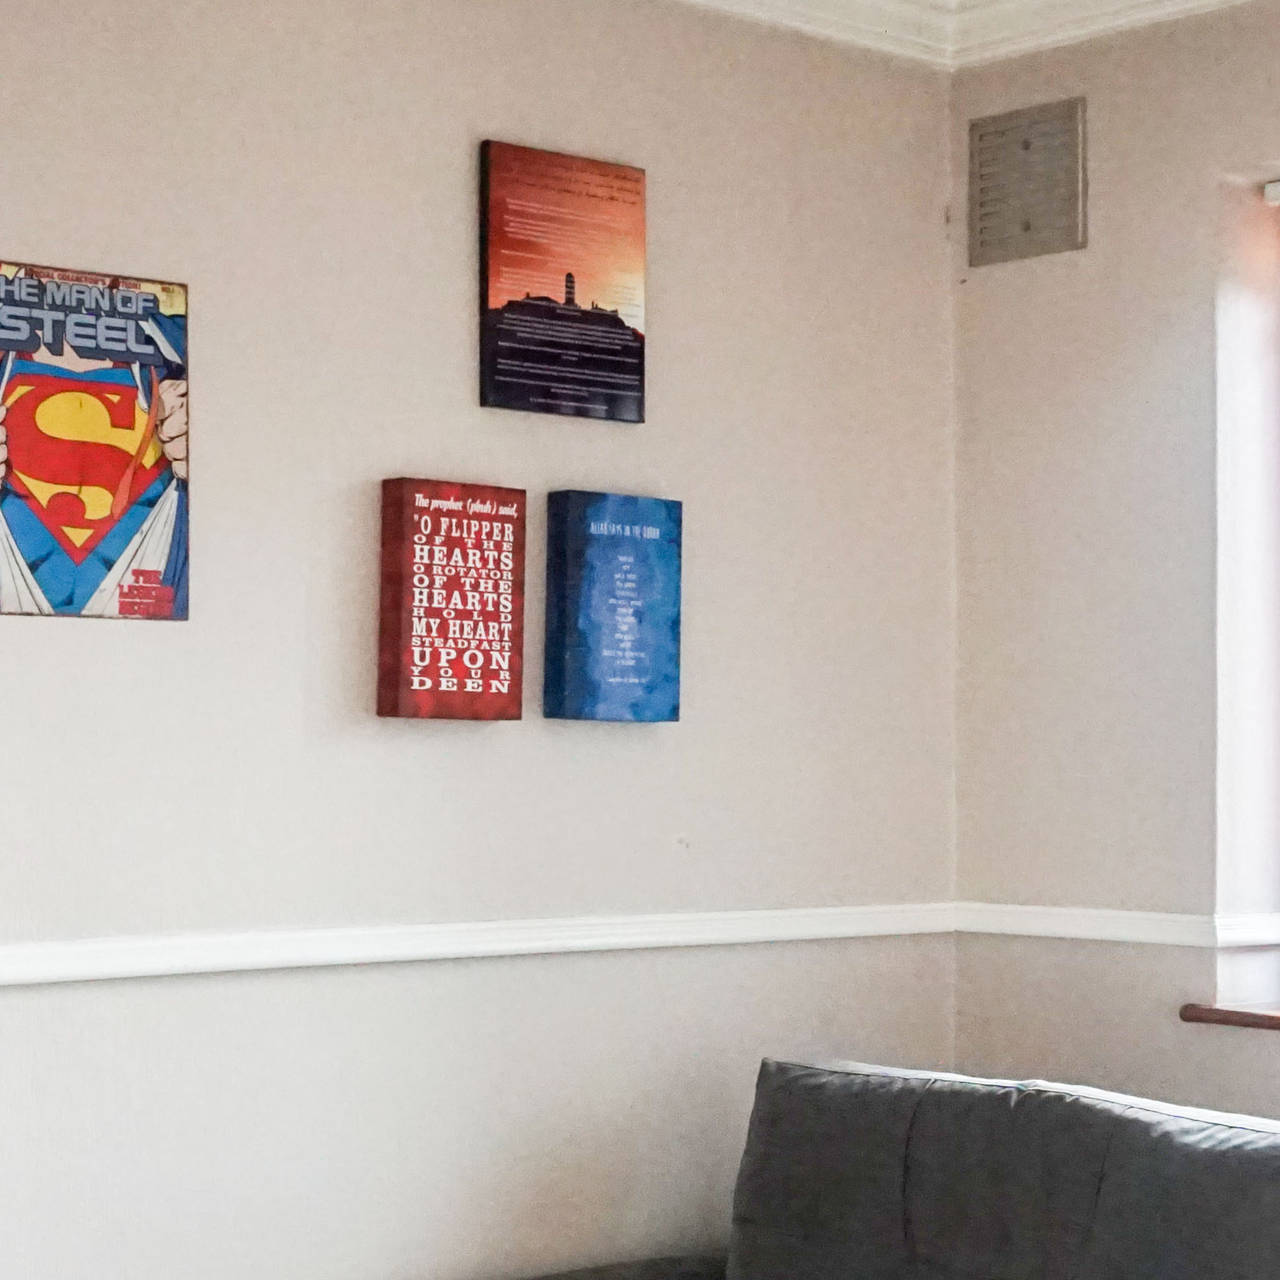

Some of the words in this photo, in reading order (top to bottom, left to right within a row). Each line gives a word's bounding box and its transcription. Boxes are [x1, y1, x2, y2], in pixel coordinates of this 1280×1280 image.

[46, 280, 110, 311] MAN
[116, 288, 157, 315] OF
[415, 493, 429, 507] The
[440, 517, 514, 542] FLIPPER
[413, 534, 445, 545] OF
[464, 538, 513, 551] THE
[413, 544, 513, 570] HEARTS
[413, 564, 424, 573] O
[432, 565, 513, 580] ROTATOR
[413, 574, 447, 589] OF
[461, 577, 512, 593] THE
[412, 587, 513, 613] HEARTS
[412, 607, 512, 622] HOLD
[412, 617, 440, 637] MY
[448, 619, 512, 641] HEART
[411, 636, 512, 651] STEADFAST
[411, 647, 511, 670] UPON
[410, 666, 511, 680] YOUR
[410, 676, 511, 693] DEEN
